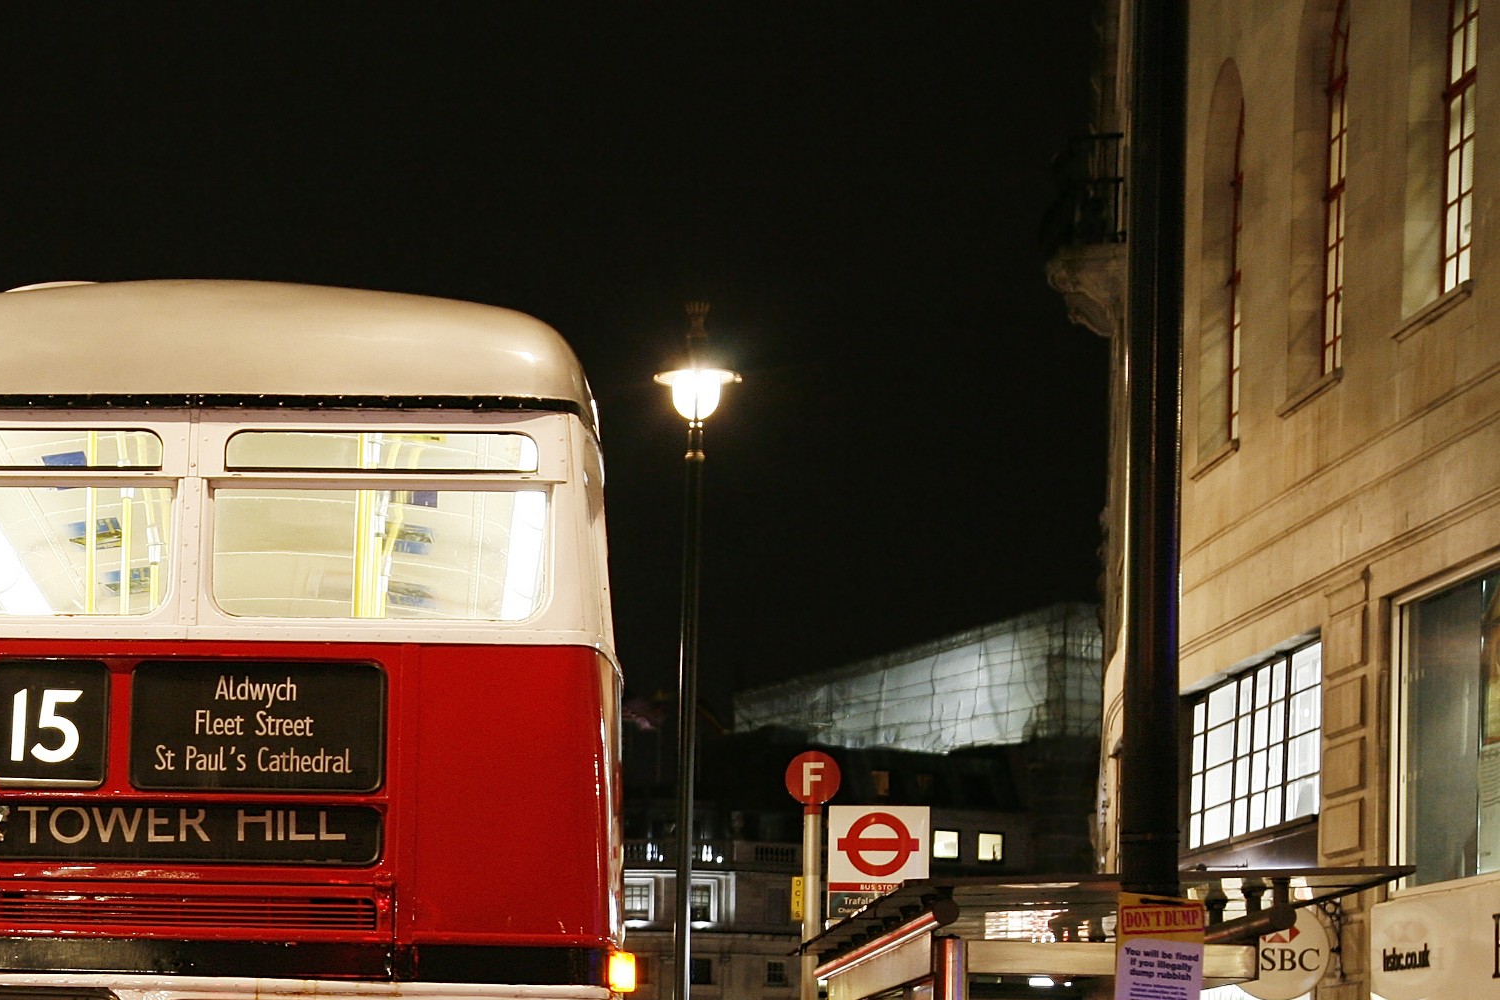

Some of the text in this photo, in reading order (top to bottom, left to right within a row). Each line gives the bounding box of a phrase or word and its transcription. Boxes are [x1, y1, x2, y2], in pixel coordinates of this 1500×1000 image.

[214, 674, 298, 709] Aldwych
[10, 688, 84, 763] 15
[195, 709, 315, 737] Fleet Street
[154, 744, 354, 774] St Paul's Cathedral
[802, 762, 825, 796] F
[17, 806, 347, 844] TOWER HILL
[860, 883, 876, 891] BUS
[1125, 909, 1199, 928] DON'T DUMP
[1125, 947, 1199, 962] You will be fined
[1139, 960, 1155, 968] you
[1157, 960, 1192, 972] illegally
[1260, 947, 1321, 972] SBC
[1383, 942, 1430, 972] hsbc.co.uk
[1129, 968, 1192, 981] dump rubbish
